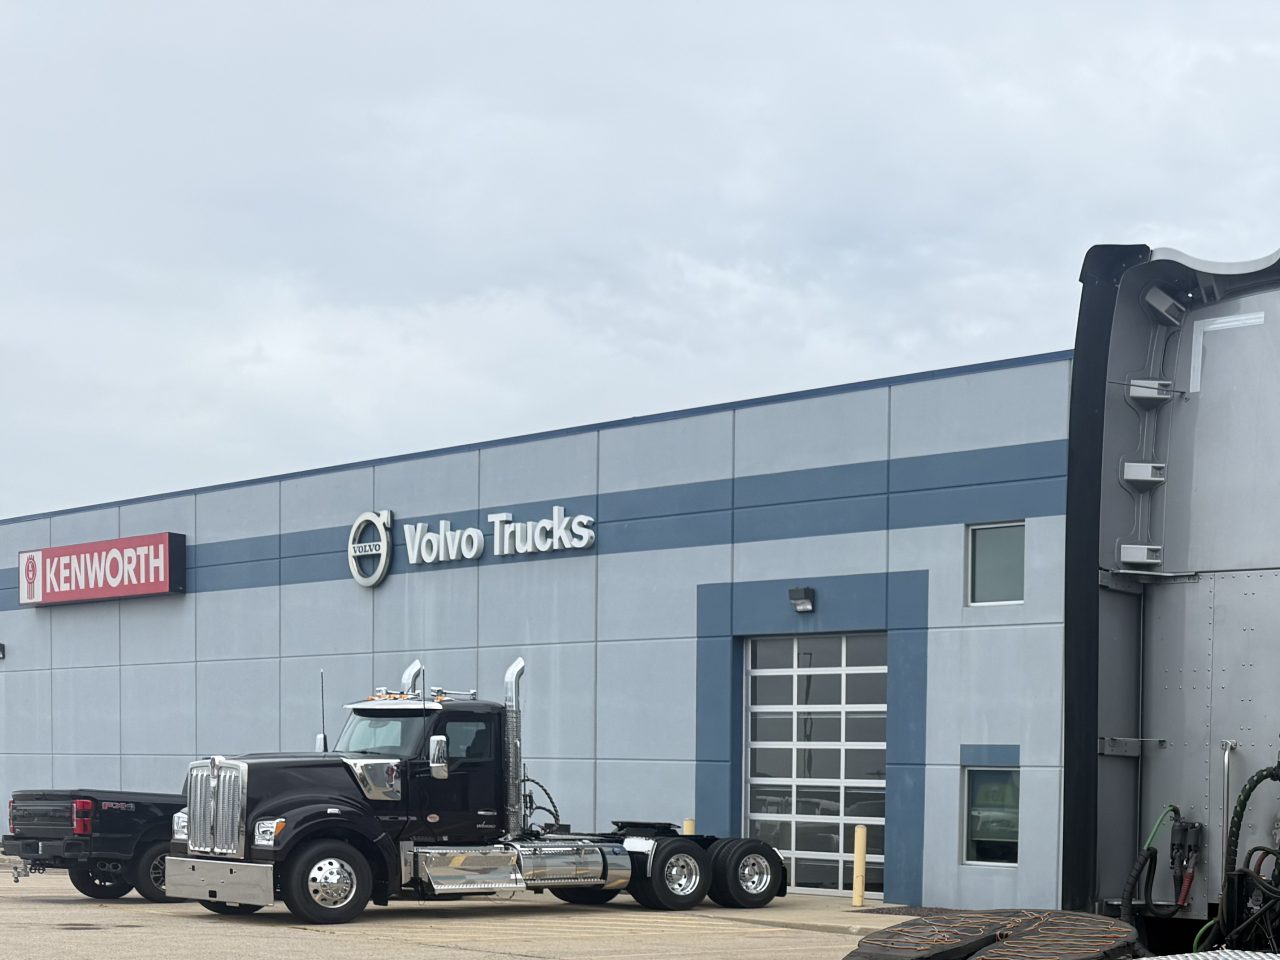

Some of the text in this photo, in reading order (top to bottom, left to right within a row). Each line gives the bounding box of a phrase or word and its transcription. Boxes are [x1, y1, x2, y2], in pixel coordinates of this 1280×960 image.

[352, 543, 381, 554] VOLVO
[403, 505, 596, 564] Volvo Trucks
[46, 544, 164, 593] KENWORTH
